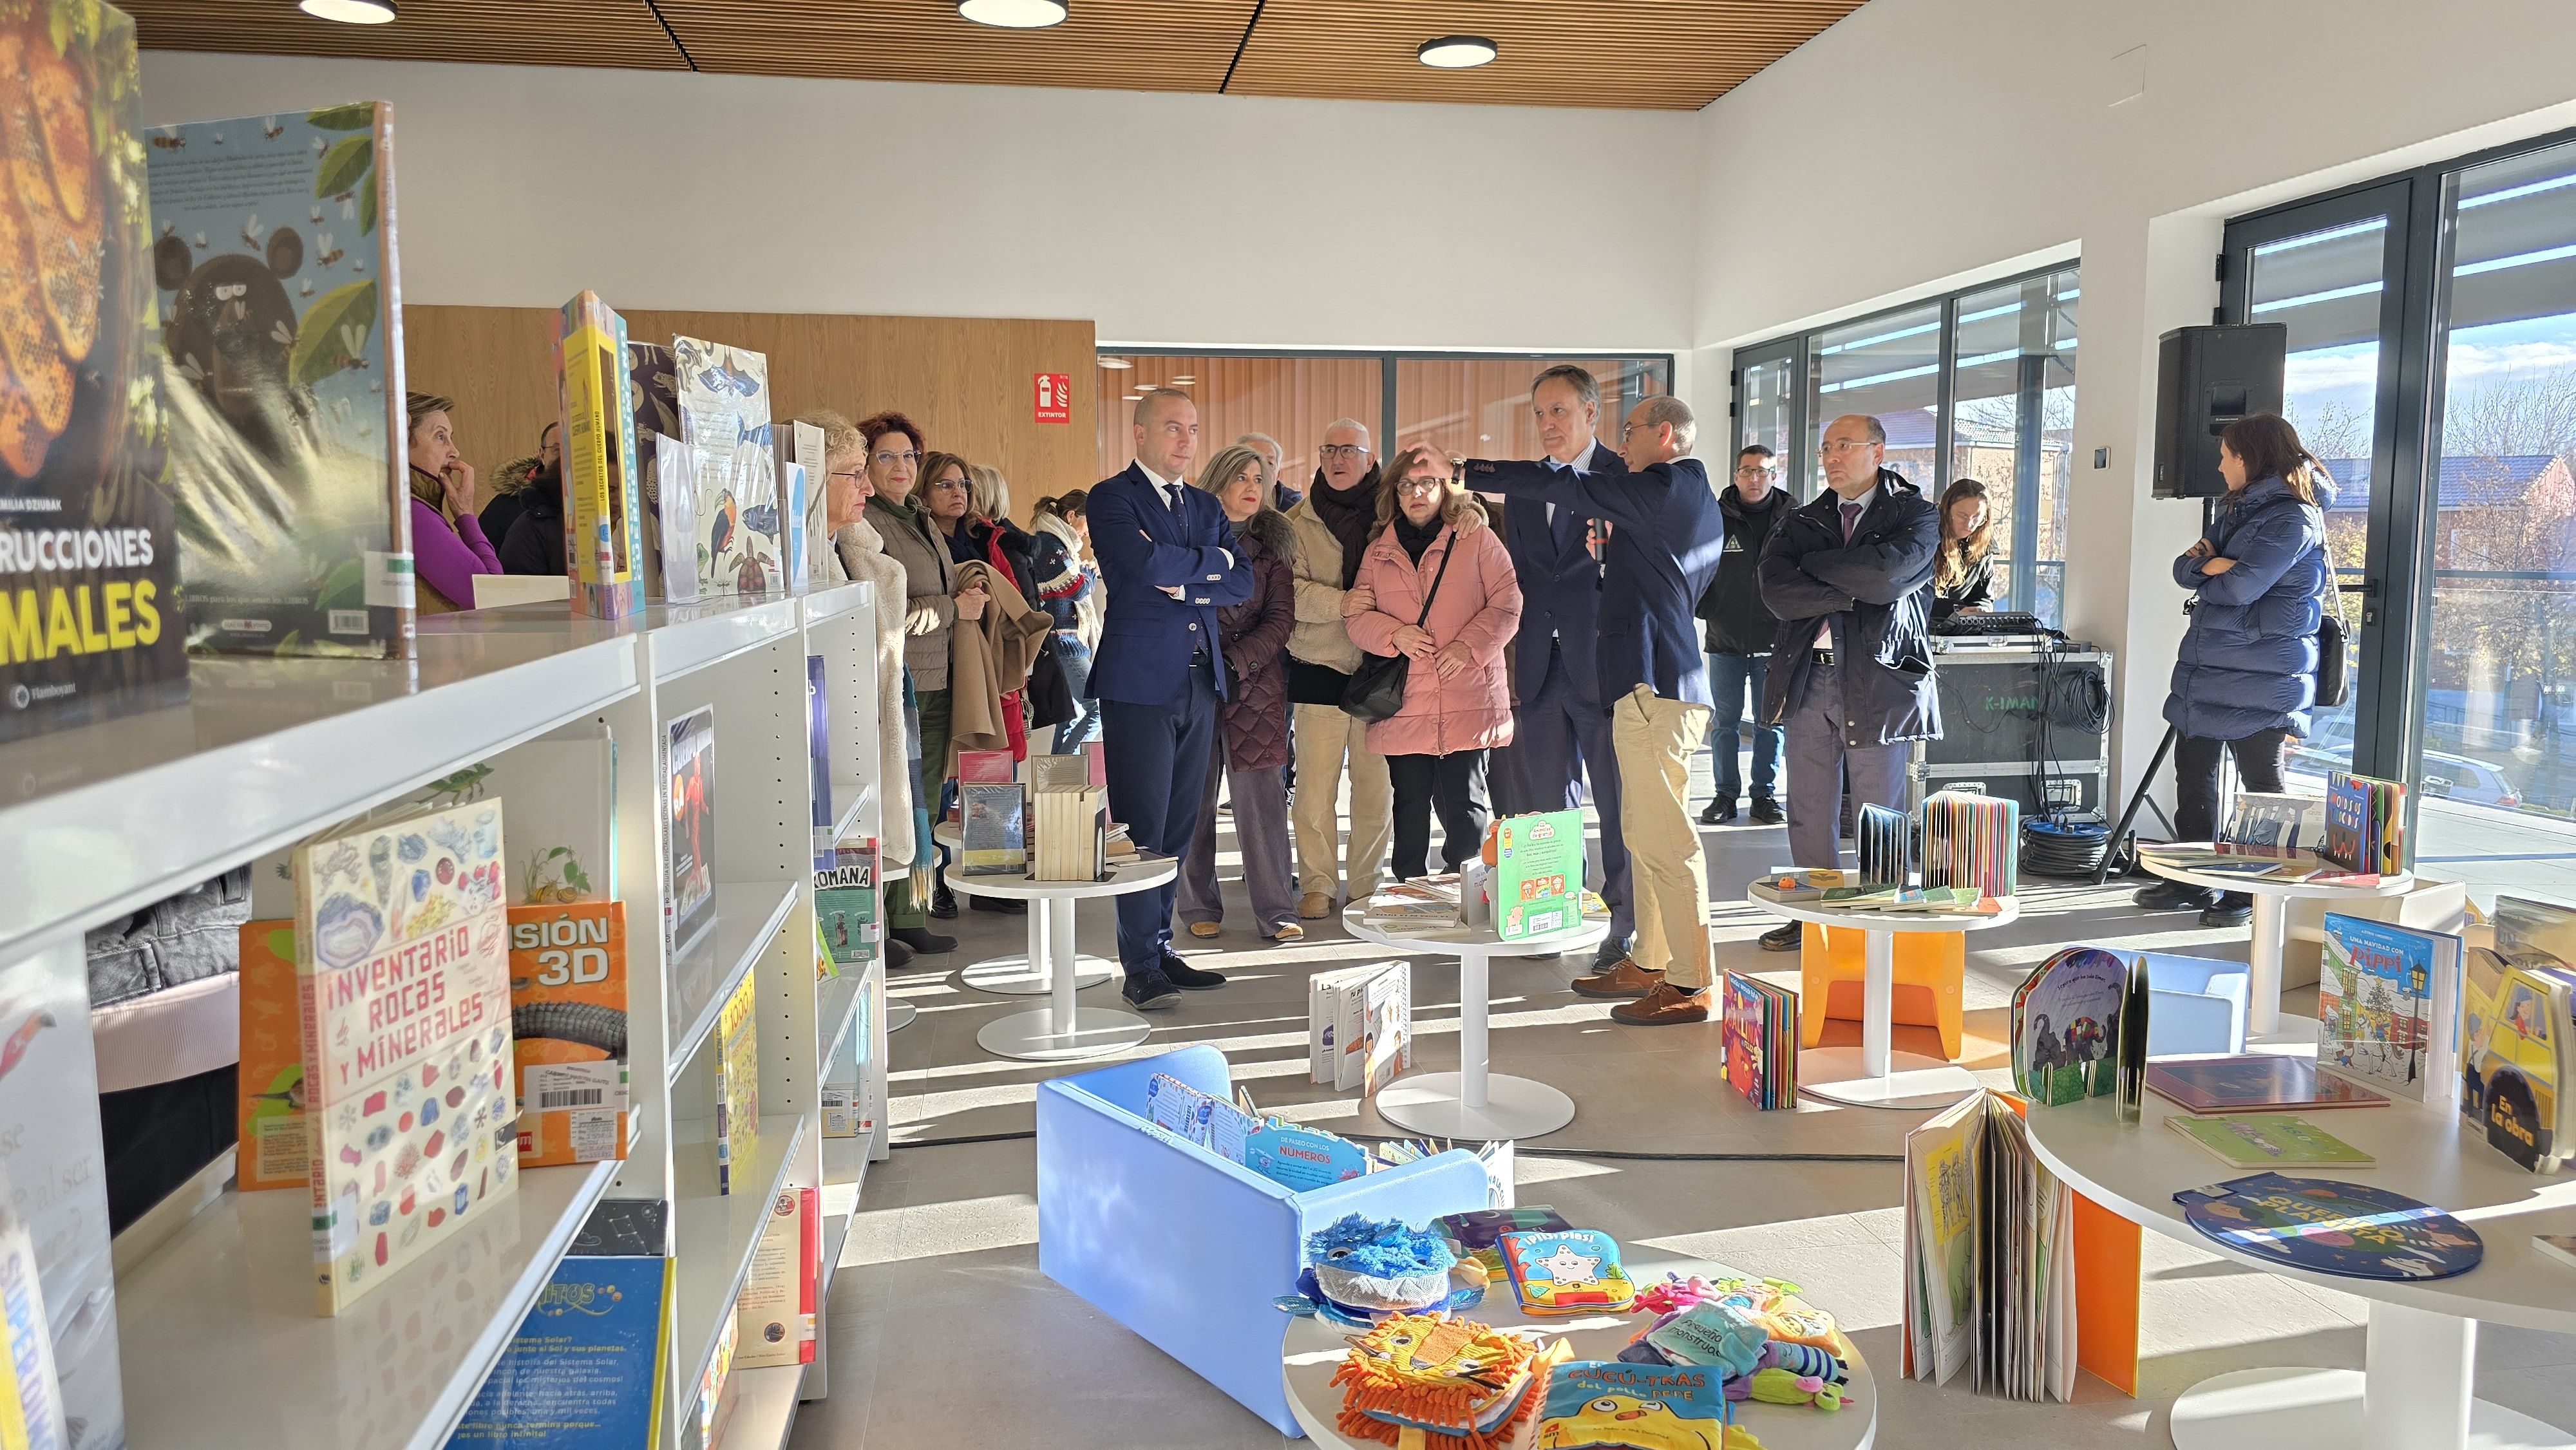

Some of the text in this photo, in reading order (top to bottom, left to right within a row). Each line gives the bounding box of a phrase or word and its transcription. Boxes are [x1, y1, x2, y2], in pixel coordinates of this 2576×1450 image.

[0, 578, 161, 666] MALES
[2349, 936, 2405, 956] UNA NAVIDAD CON
[538, 947, 609, 986] 3D
[2499, 1095, 2512, 1114] En
[2491, 1103, 2534, 1148] la obra
[1288, 1137, 1305, 1147] PASEO
[1305, 1140, 1319, 1149] CON
[1279, 1144, 1331, 1164] NÚMEROS
[1568, 1368, 1705, 1388] CUCÚ-TRAS
[1577, 1380, 1694, 1402] del pollo PEPE
